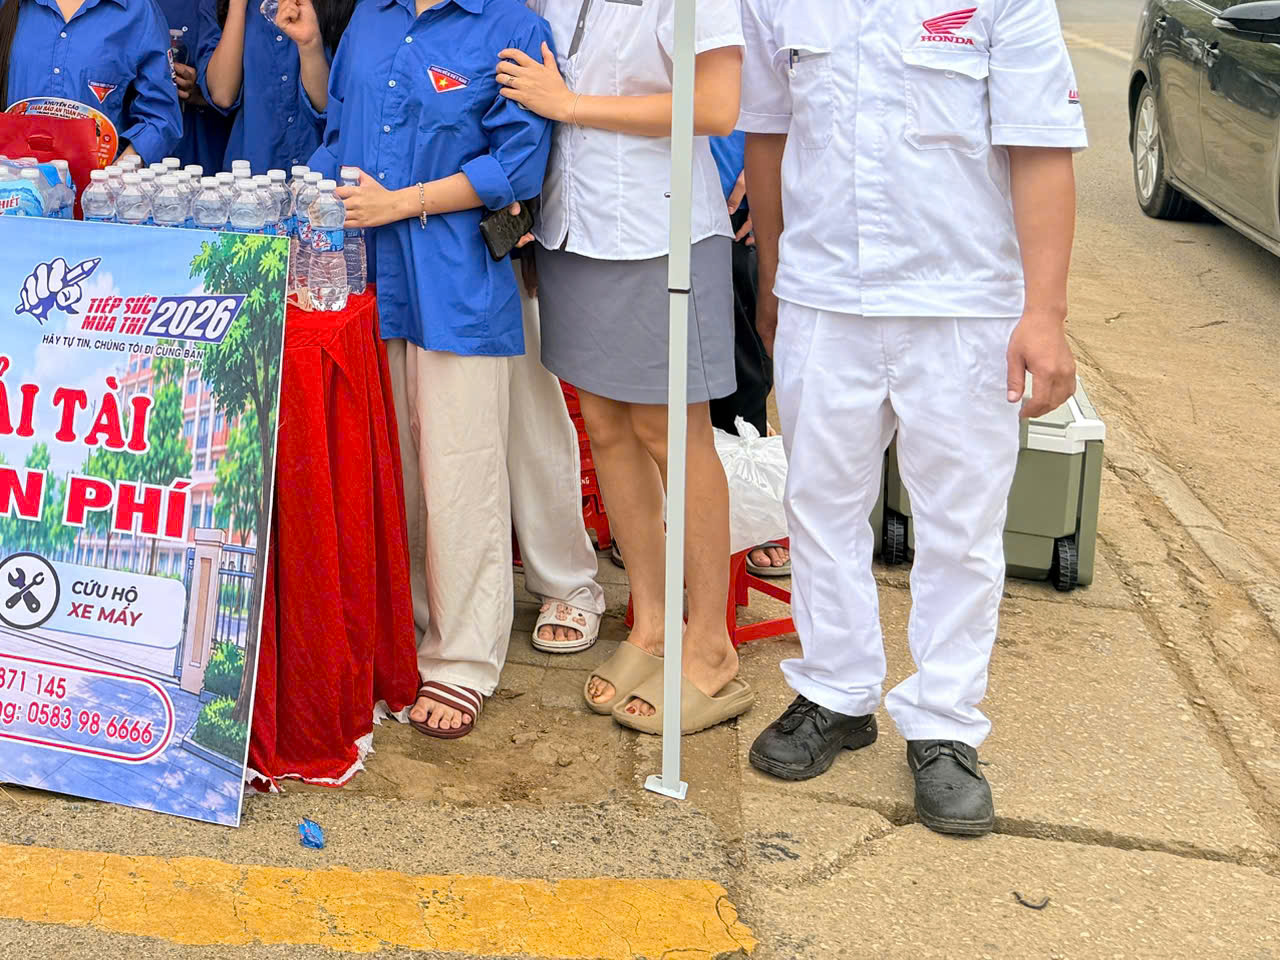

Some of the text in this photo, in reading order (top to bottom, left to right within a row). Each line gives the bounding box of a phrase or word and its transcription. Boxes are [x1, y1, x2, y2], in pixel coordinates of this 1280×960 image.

[920, 35, 975, 45] HONDA
[81, 313, 146, 335] MÙA THI
[88, 293, 237, 340] TIẾP SỨC 2026
[42, 334, 204, 361] HÃY TỰ TIN, CHÚNG TÔI ĐI CÙNG BẠN
[53, 376, 152, 451] TÀI
[65, 477, 191, 539] PHÍ
[72, 579, 138, 604] CỨU HỘ
[67, 601, 143, 628] XE MÁY
[36, 674, 67, 700] 145
[27, 701, 72, 730] 0583
[78, 710, 100, 736] 98
[106, 715, 153, 746] 6666
